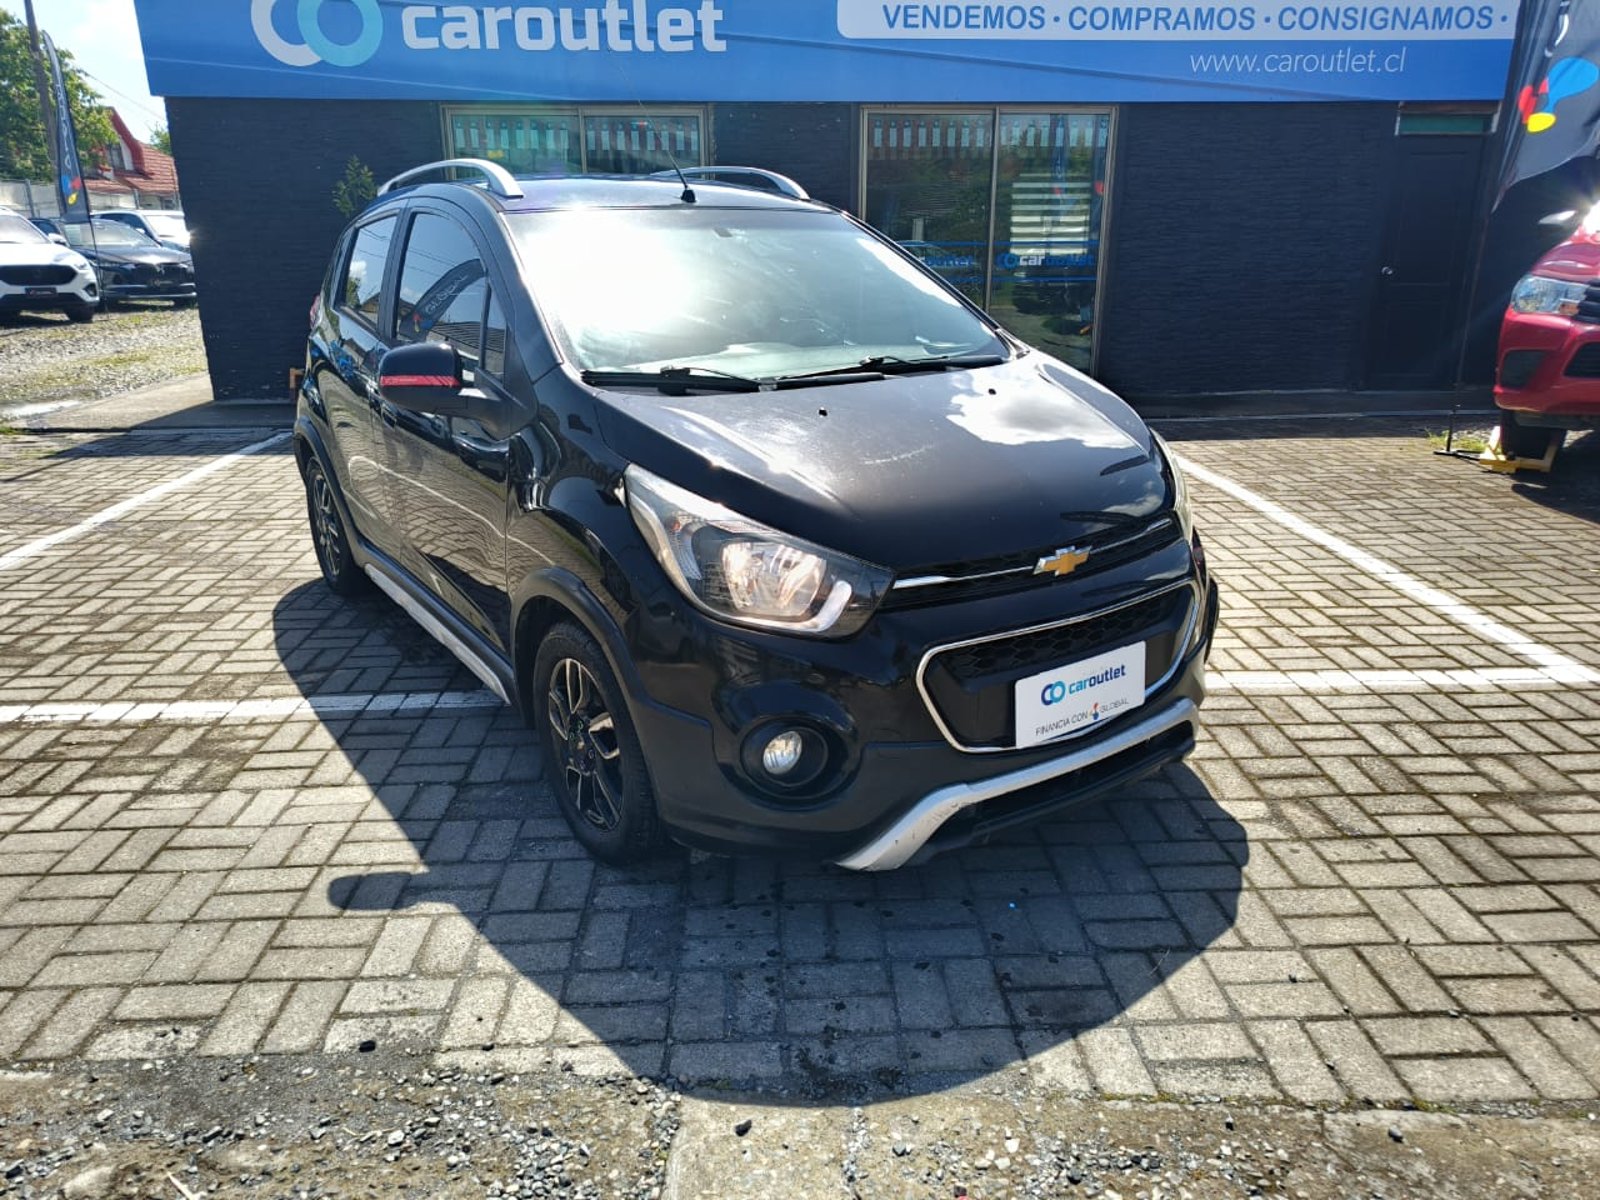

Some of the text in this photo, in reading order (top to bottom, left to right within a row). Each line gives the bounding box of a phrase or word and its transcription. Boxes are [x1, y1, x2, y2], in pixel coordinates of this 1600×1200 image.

[402, 0, 727, 52] caroutlet
[883, 5, 1495, 32] VENDEMOS COMPRAMOS CONSIGNAMOS
[1189, 47, 1406, 76] www.caroutlet.cl
[1069, 665, 1125, 694] caroutlet
[1035, 718, 1070, 736] FINANCIA
[1071, 711, 1088, 723] CON
